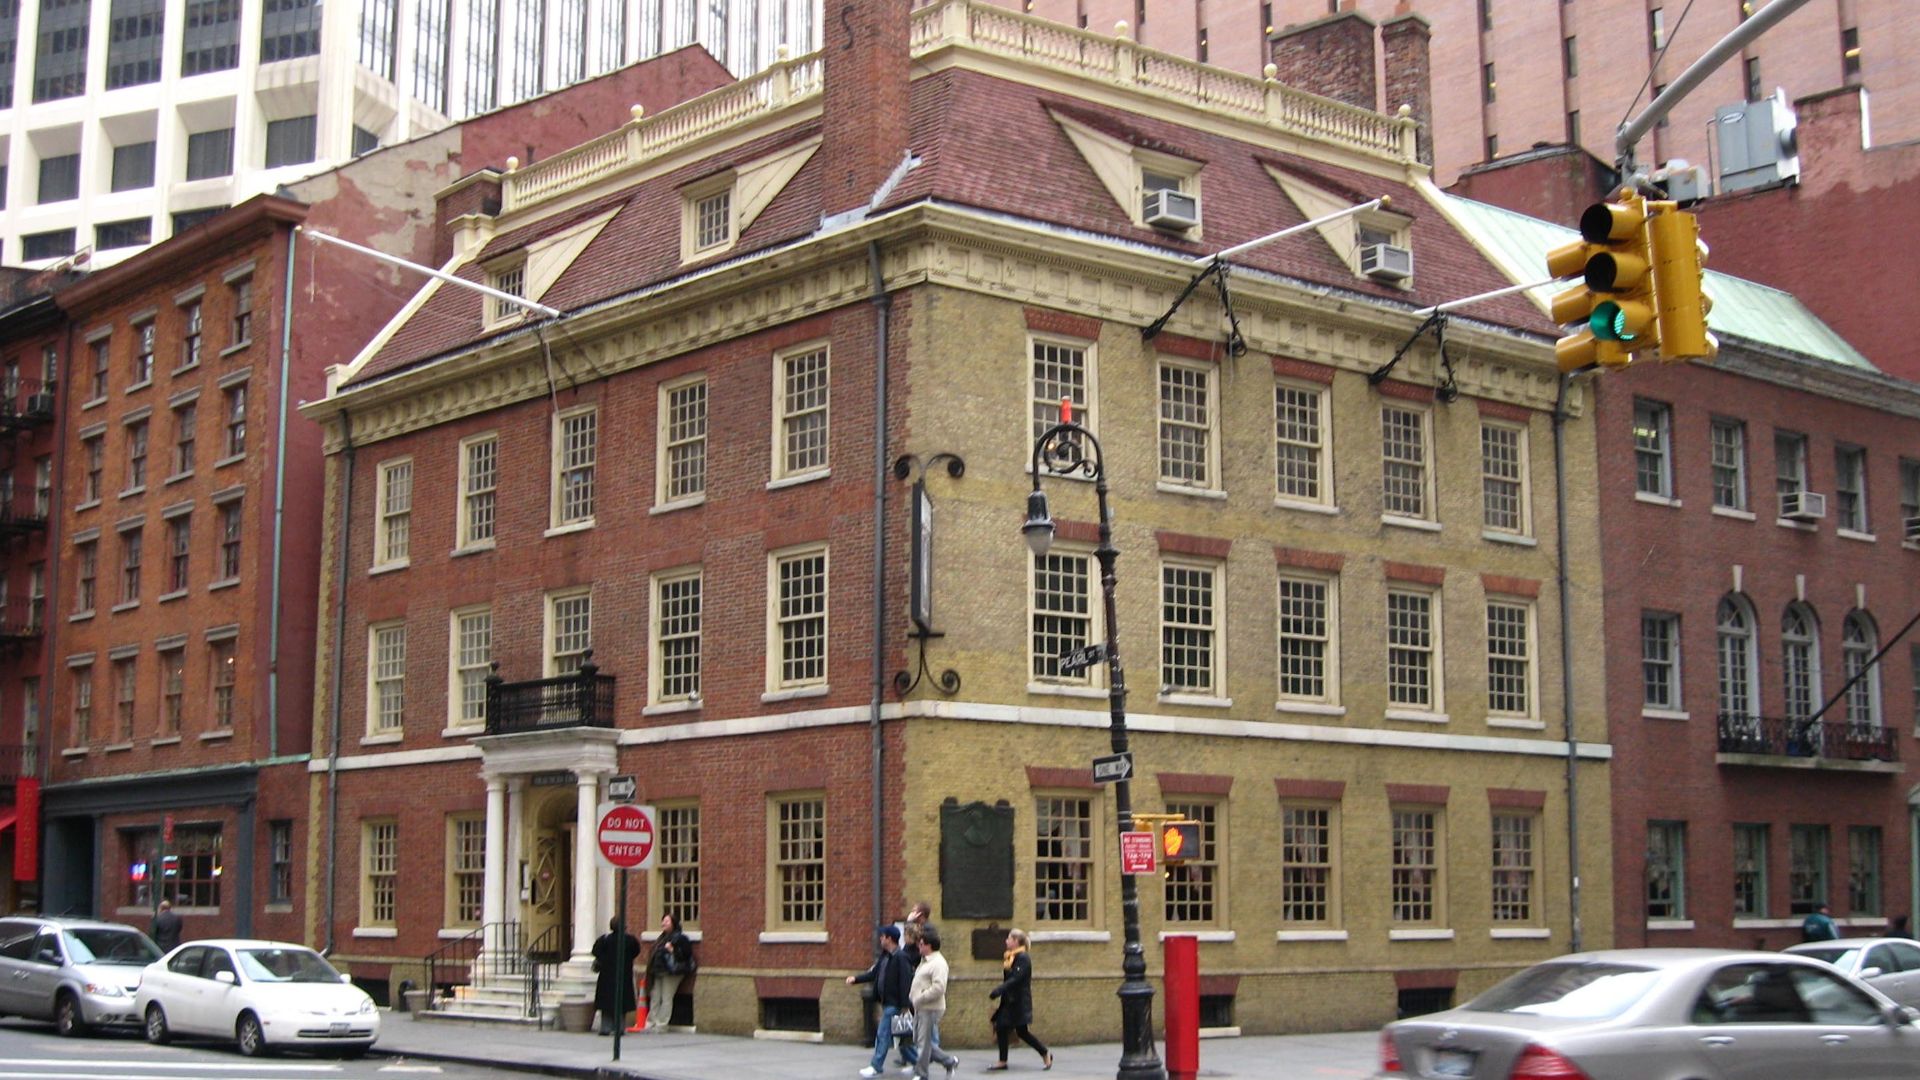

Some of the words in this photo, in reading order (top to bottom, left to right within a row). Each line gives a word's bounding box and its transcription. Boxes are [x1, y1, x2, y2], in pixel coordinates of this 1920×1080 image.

[1060, 650, 1088, 668] PEARL
[607, 817, 621, 828] DO
[625, 818, 645, 829] NOT
[608, 845, 642, 856] ENTER
